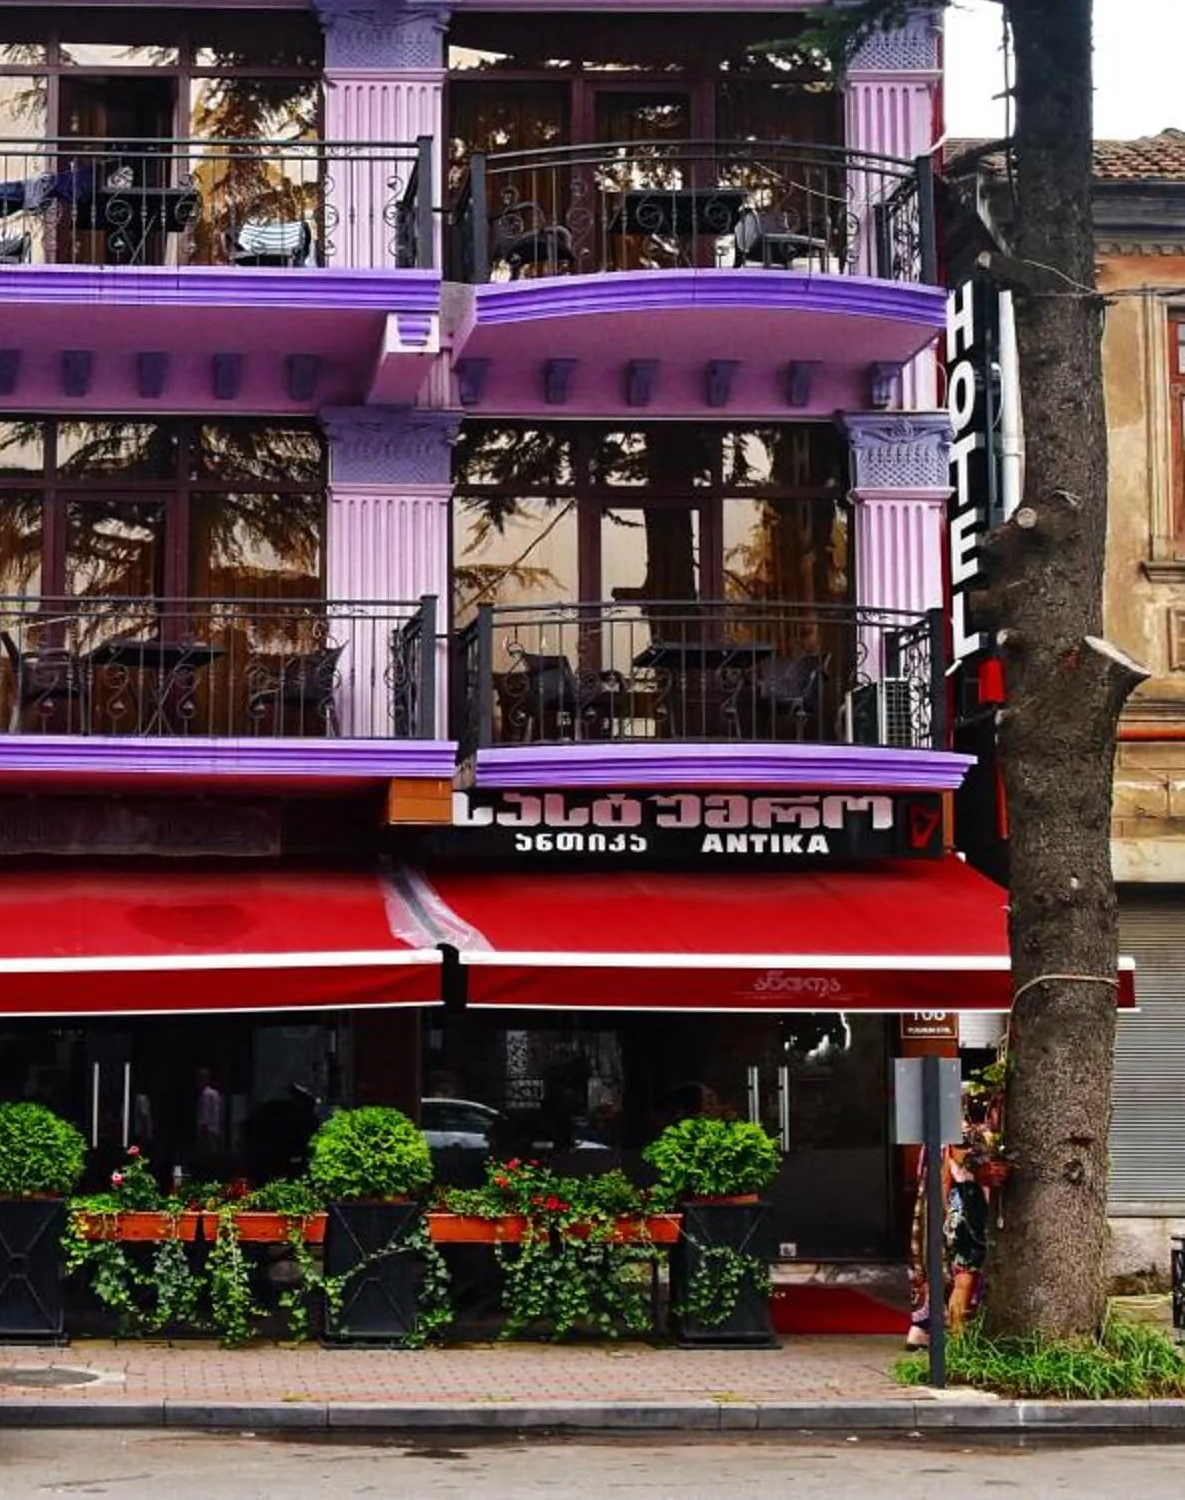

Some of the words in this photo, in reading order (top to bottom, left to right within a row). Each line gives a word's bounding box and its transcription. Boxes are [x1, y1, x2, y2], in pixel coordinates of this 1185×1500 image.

[946, 279, 980, 660] HOTEL
[451, 791, 894, 830] სასტუმრო
[515, 832, 648, 852] ანთიკა
[701, 833, 830, 853] ANTIKA
